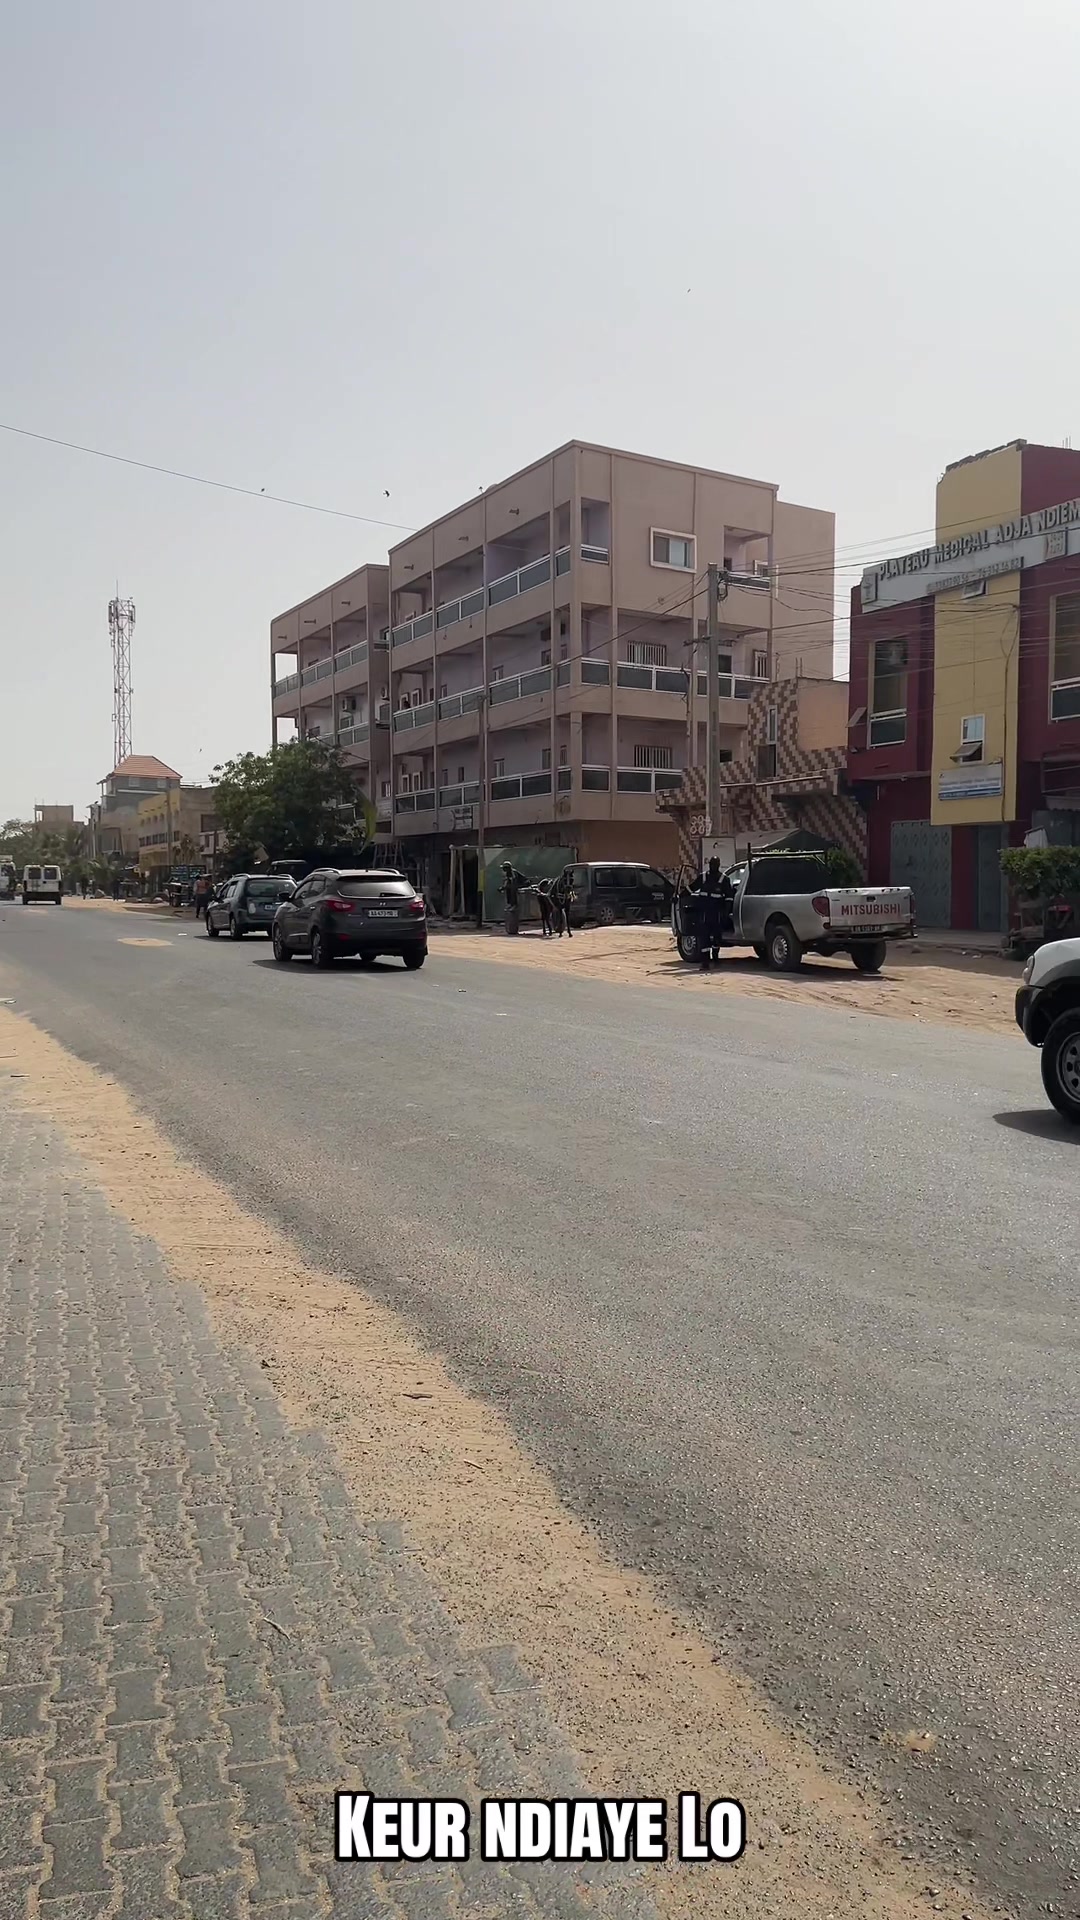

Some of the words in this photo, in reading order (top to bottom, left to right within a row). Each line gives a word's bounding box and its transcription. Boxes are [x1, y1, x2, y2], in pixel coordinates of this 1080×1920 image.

[878, 548, 930, 581] PLATEAU
[934, 530, 990, 565] MEDICAL
[995, 515, 1032, 545] ADJA
[841, 903, 900, 916] MITSUBISHI
